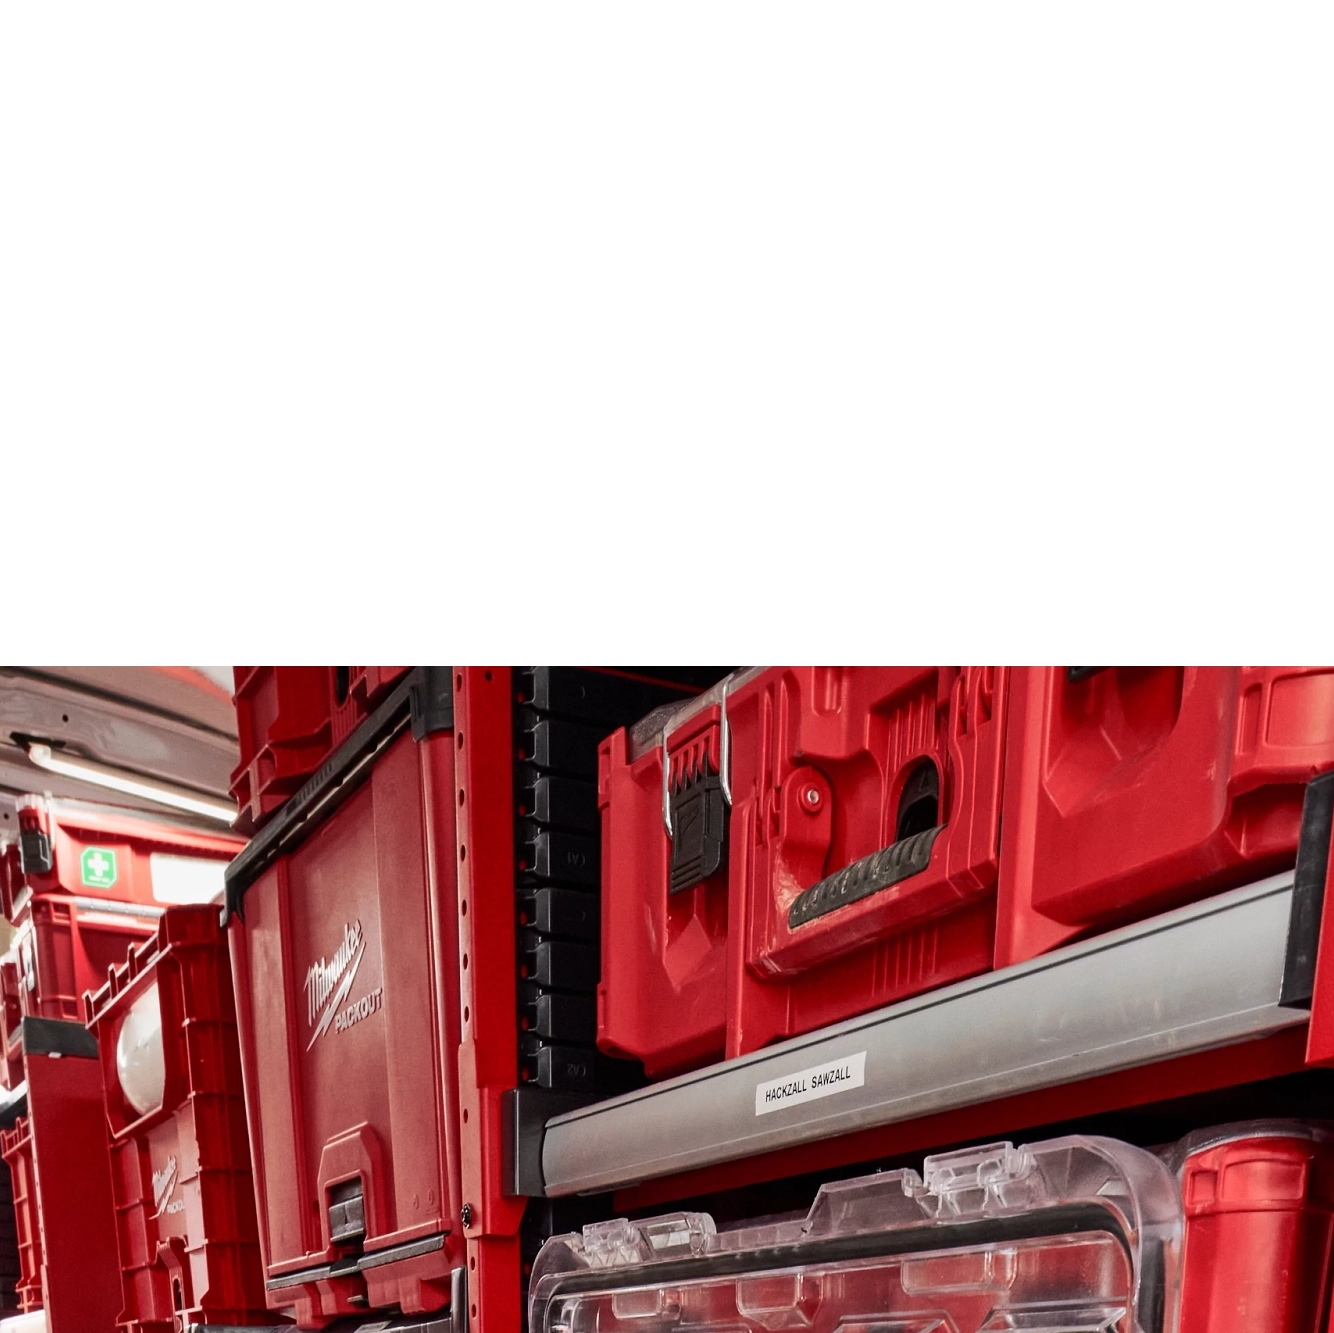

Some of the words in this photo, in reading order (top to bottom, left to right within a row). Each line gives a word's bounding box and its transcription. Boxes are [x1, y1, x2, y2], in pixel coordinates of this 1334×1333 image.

[303, 919, 364, 1027] Milwaukee
[334, 987, 383, 1035] PACKOUT
[765, 1079, 807, 1103] HACKZALL
[811, 1065, 851, 1090] SAWZALL
